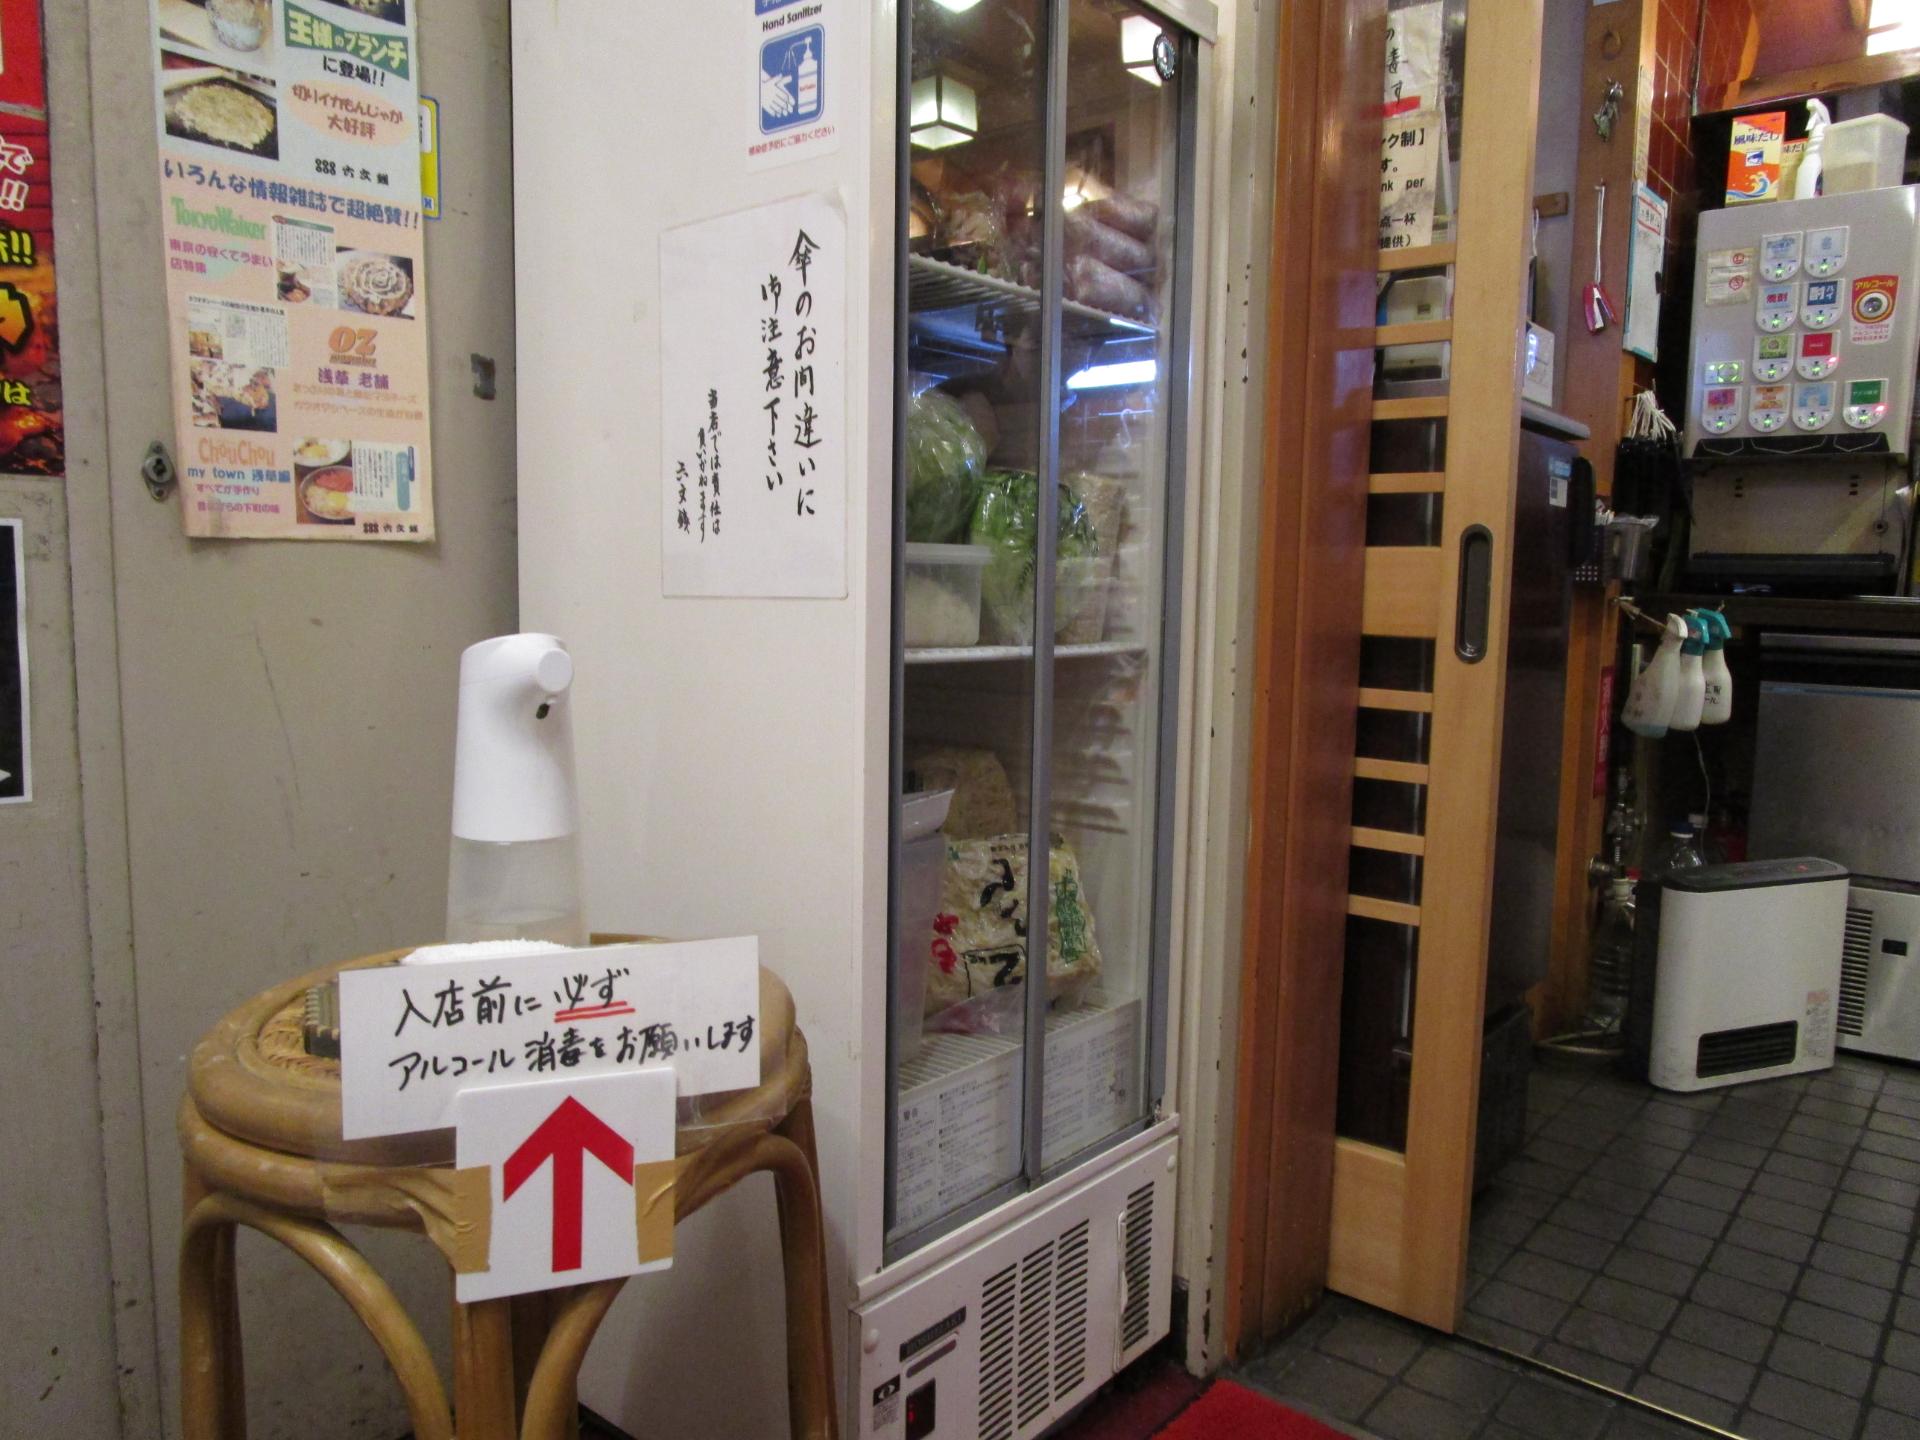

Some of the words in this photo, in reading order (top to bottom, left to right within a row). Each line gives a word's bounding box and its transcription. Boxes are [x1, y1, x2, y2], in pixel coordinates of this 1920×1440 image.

[762, 16, 785, 33] Hand
[786, 3, 823, 24] Sanitizer
[286, 8, 408, 70] 王様のブランチ
[322, 55, 386, 88] に登場!!
[326, 112, 377, 140] 大好評
[1733, 131, 1780, 146] 風味だし
[164, 158, 419, 230] いろんな情報雑誌で超絶賛!!
[1406, 178, 1425, 191] per
[328, 326, 378, 356] OZ
[358, 371, 389, 390] 老舗
[788, 228, 822, 516] 傘のお間違いに
[198, 437, 275, 467] ChouChou
[707, 388, 722, 535] 当店では責任は
[187, 467, 206, 479] my
[212, 467, 246, 480] town
[196, 484, 260, 496] すべてが手作り
